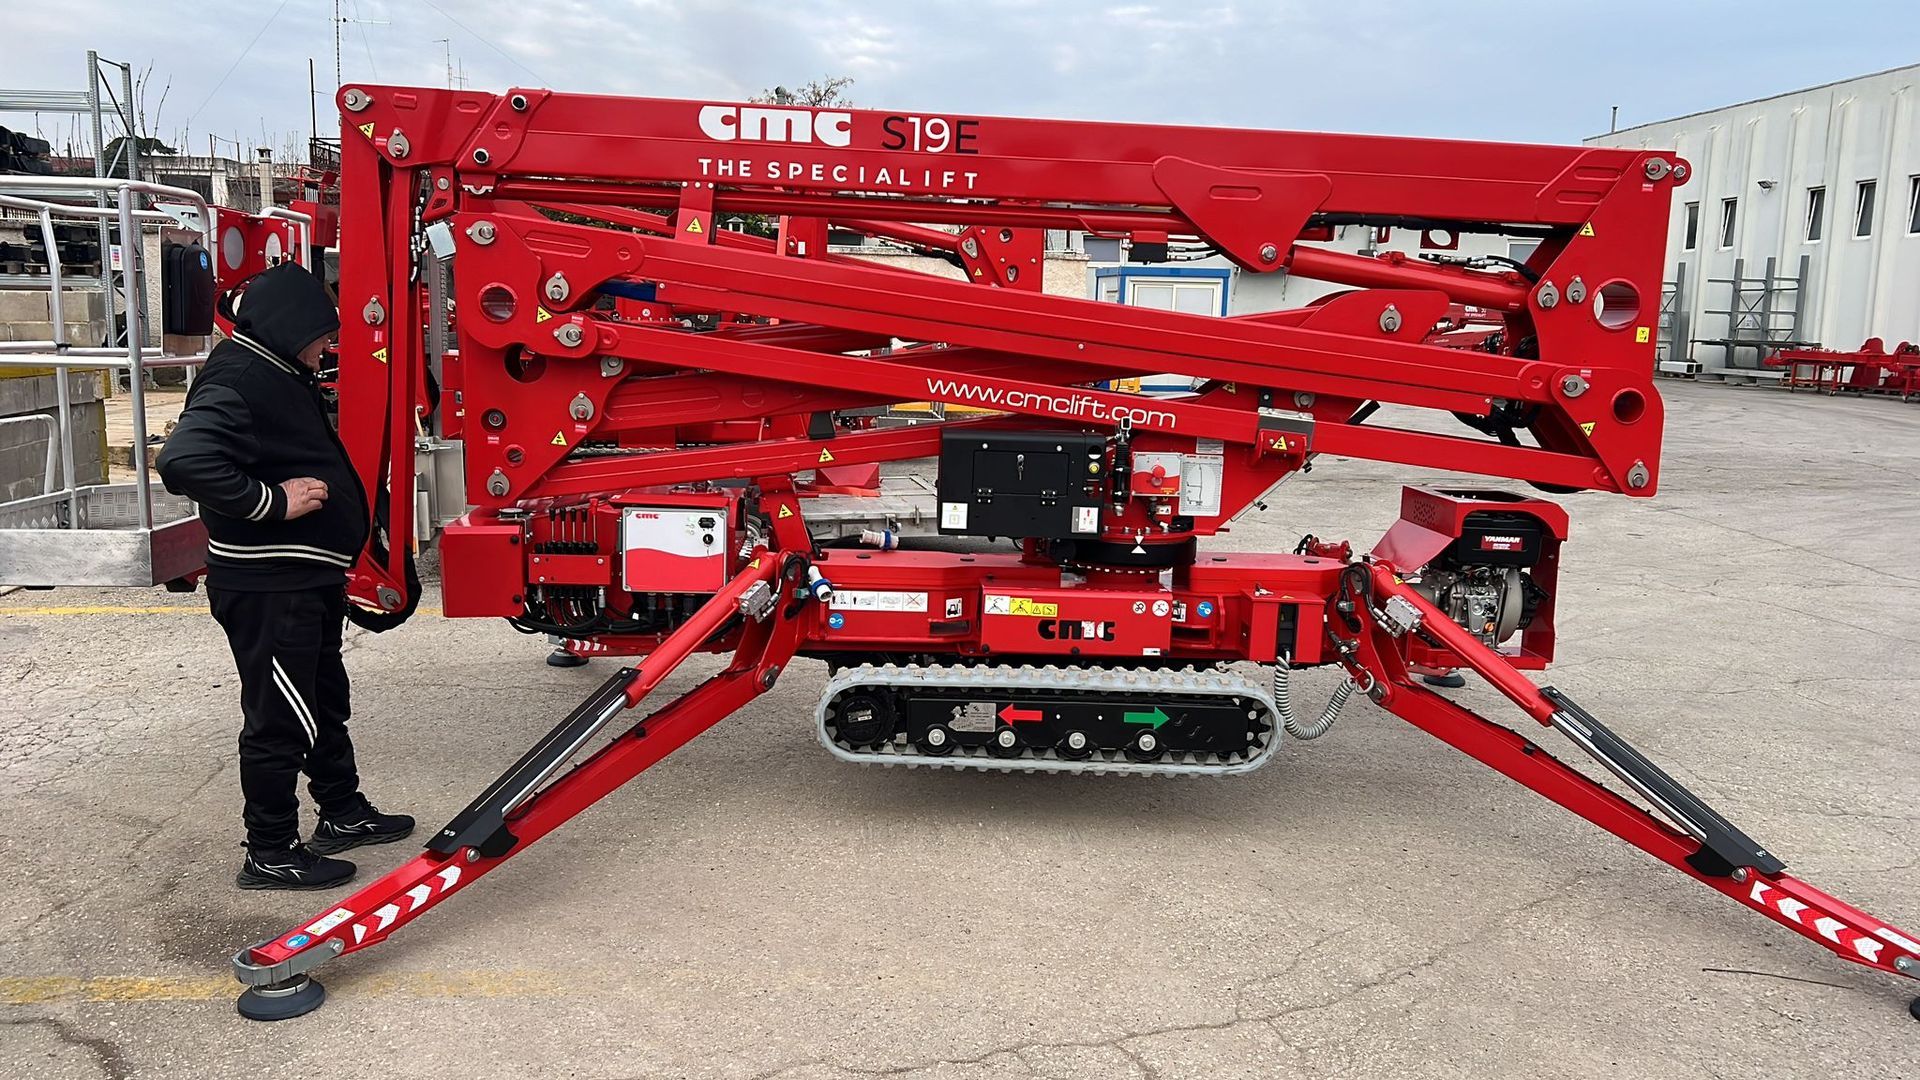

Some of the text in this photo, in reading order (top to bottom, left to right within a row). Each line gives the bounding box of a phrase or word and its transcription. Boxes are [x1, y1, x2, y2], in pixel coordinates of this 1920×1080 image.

[881, 116, 980, 155] S19E
[698, 158, 978, 190] THE SPECIALIFT
[926, 378, 1176, 428] www.cmclift.com
[1484, 535, 1521, 543] YANMAR
